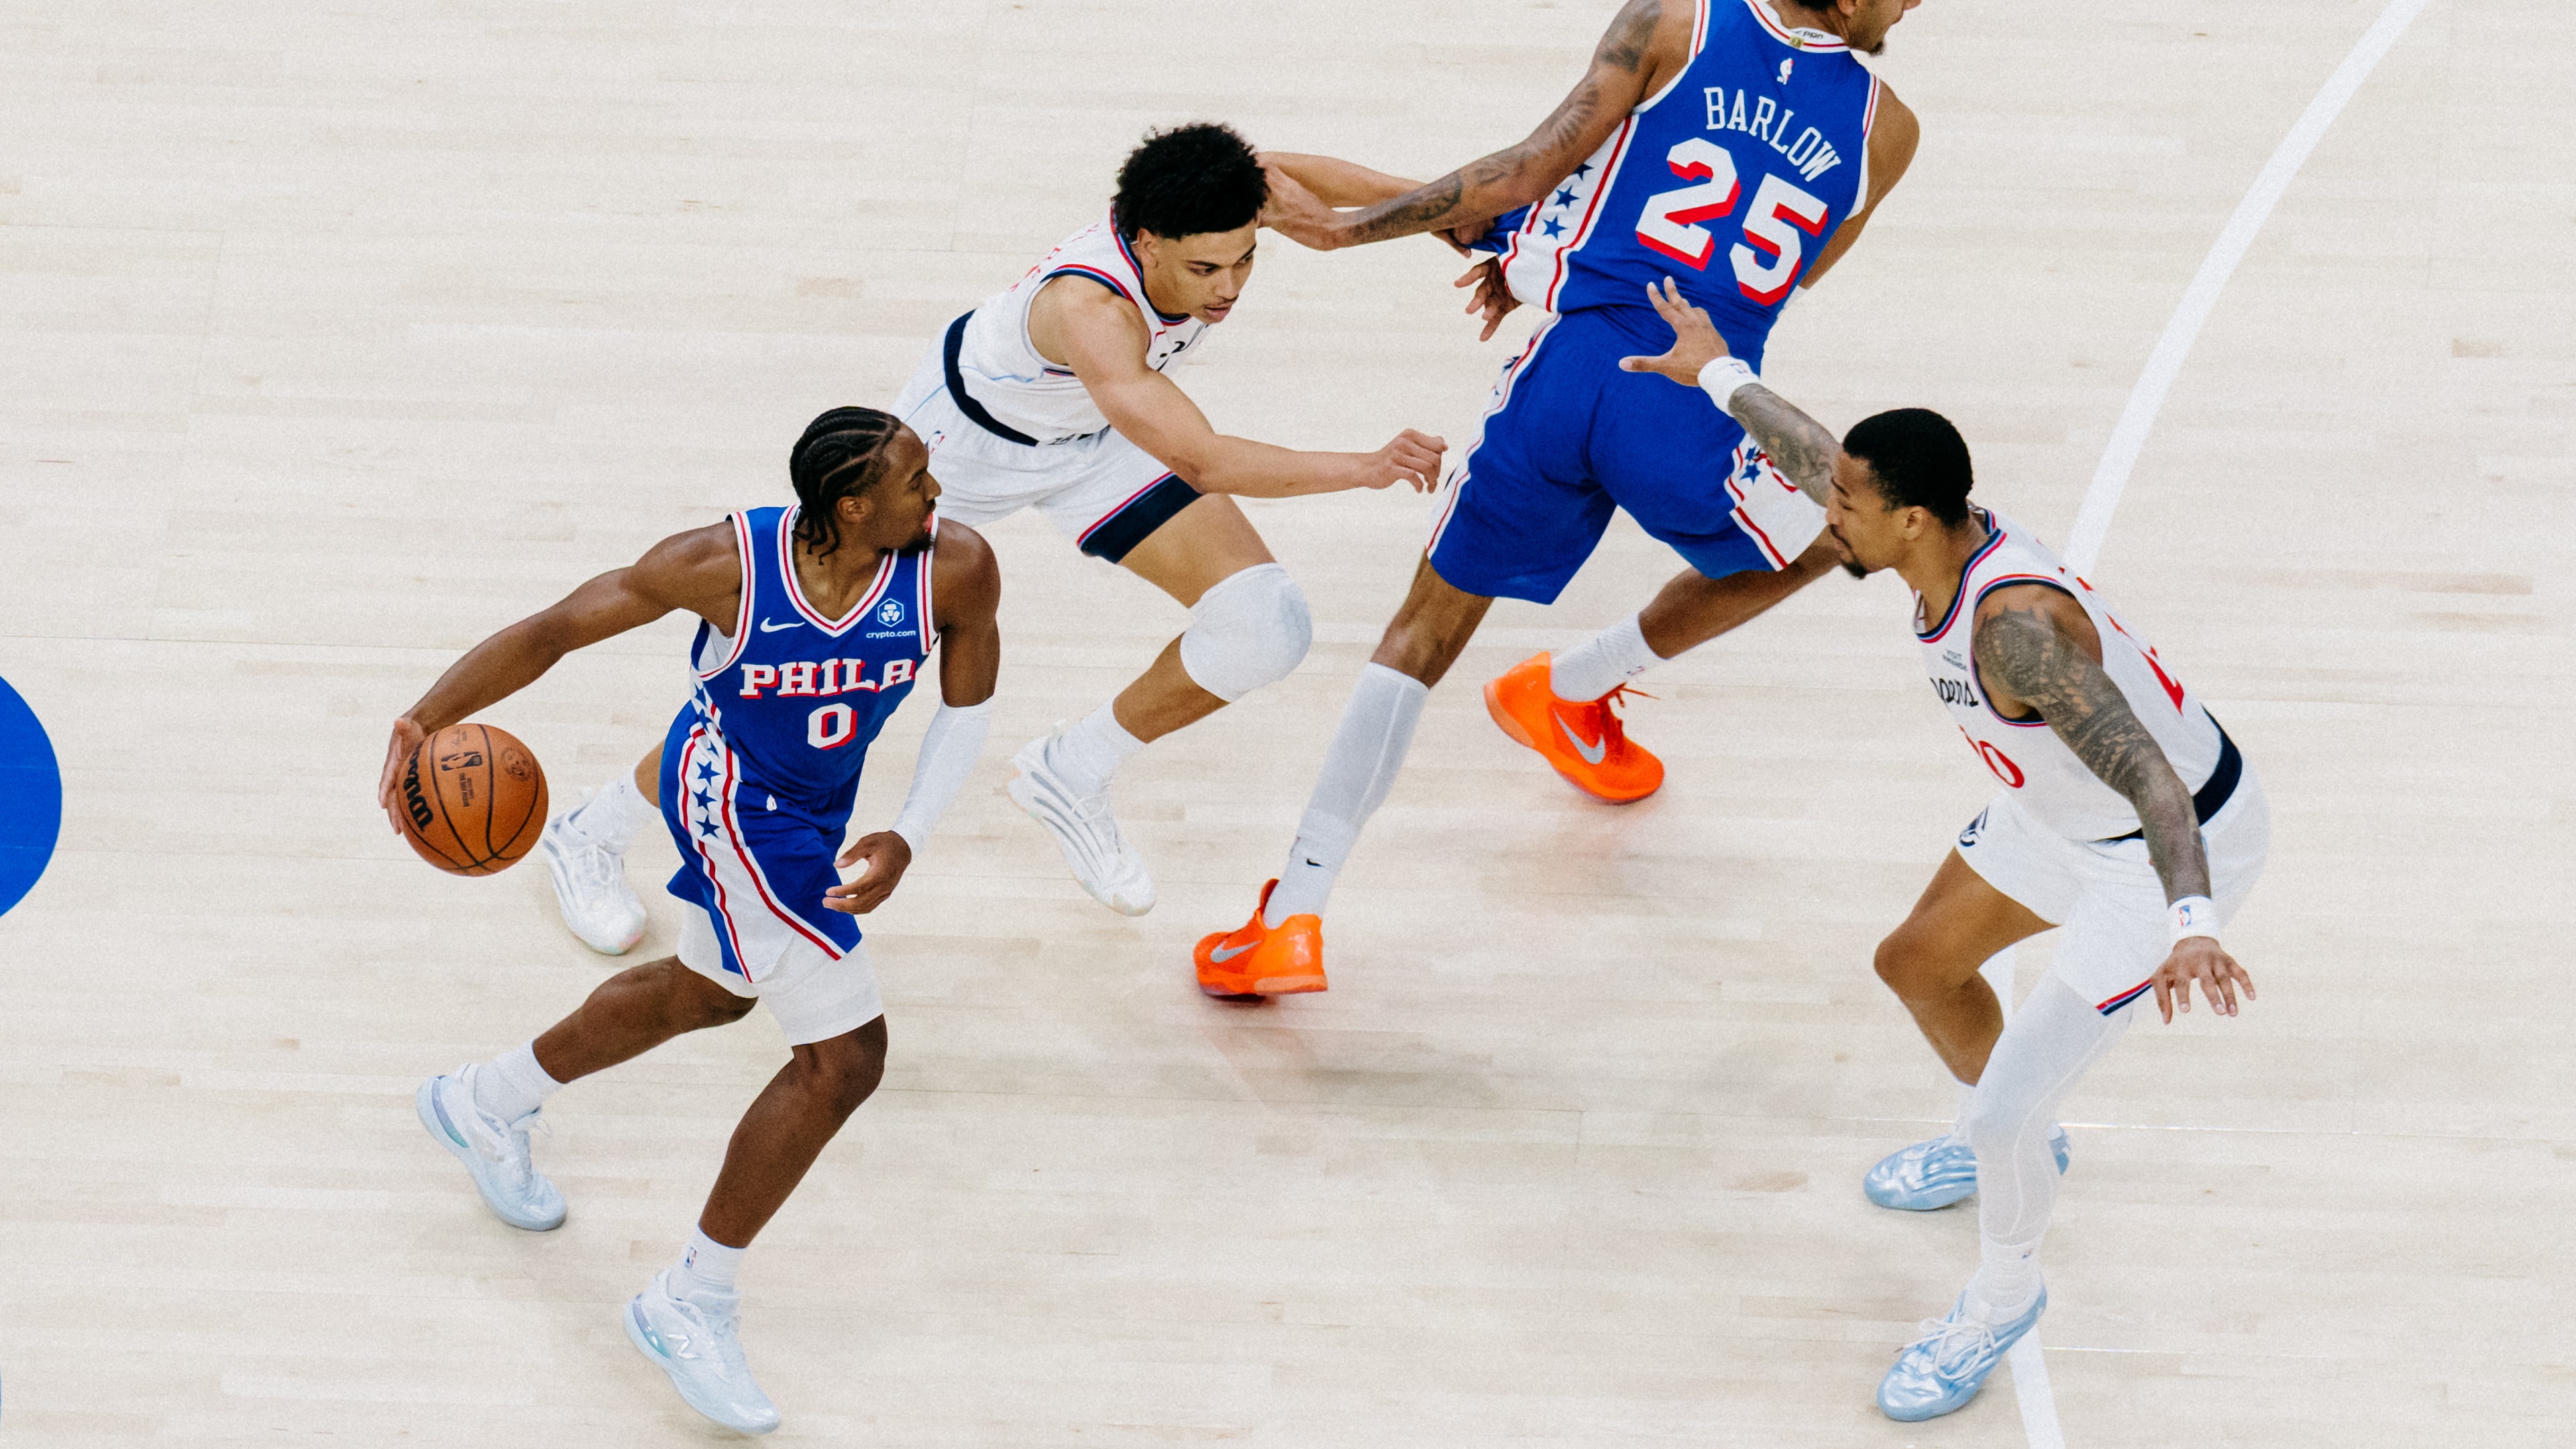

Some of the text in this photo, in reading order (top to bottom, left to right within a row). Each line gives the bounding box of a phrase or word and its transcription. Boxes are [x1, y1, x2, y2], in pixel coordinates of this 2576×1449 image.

[1703, 87, 1841, 182] BARLOW
[1635, 137, 1829, 307] 25
[865, 630, 916, 639] crypto.com
[739, 658, 917, 700] PHILA
[807, 702, 858, 751] 0
[1958, 724, 2025, 789] 0
